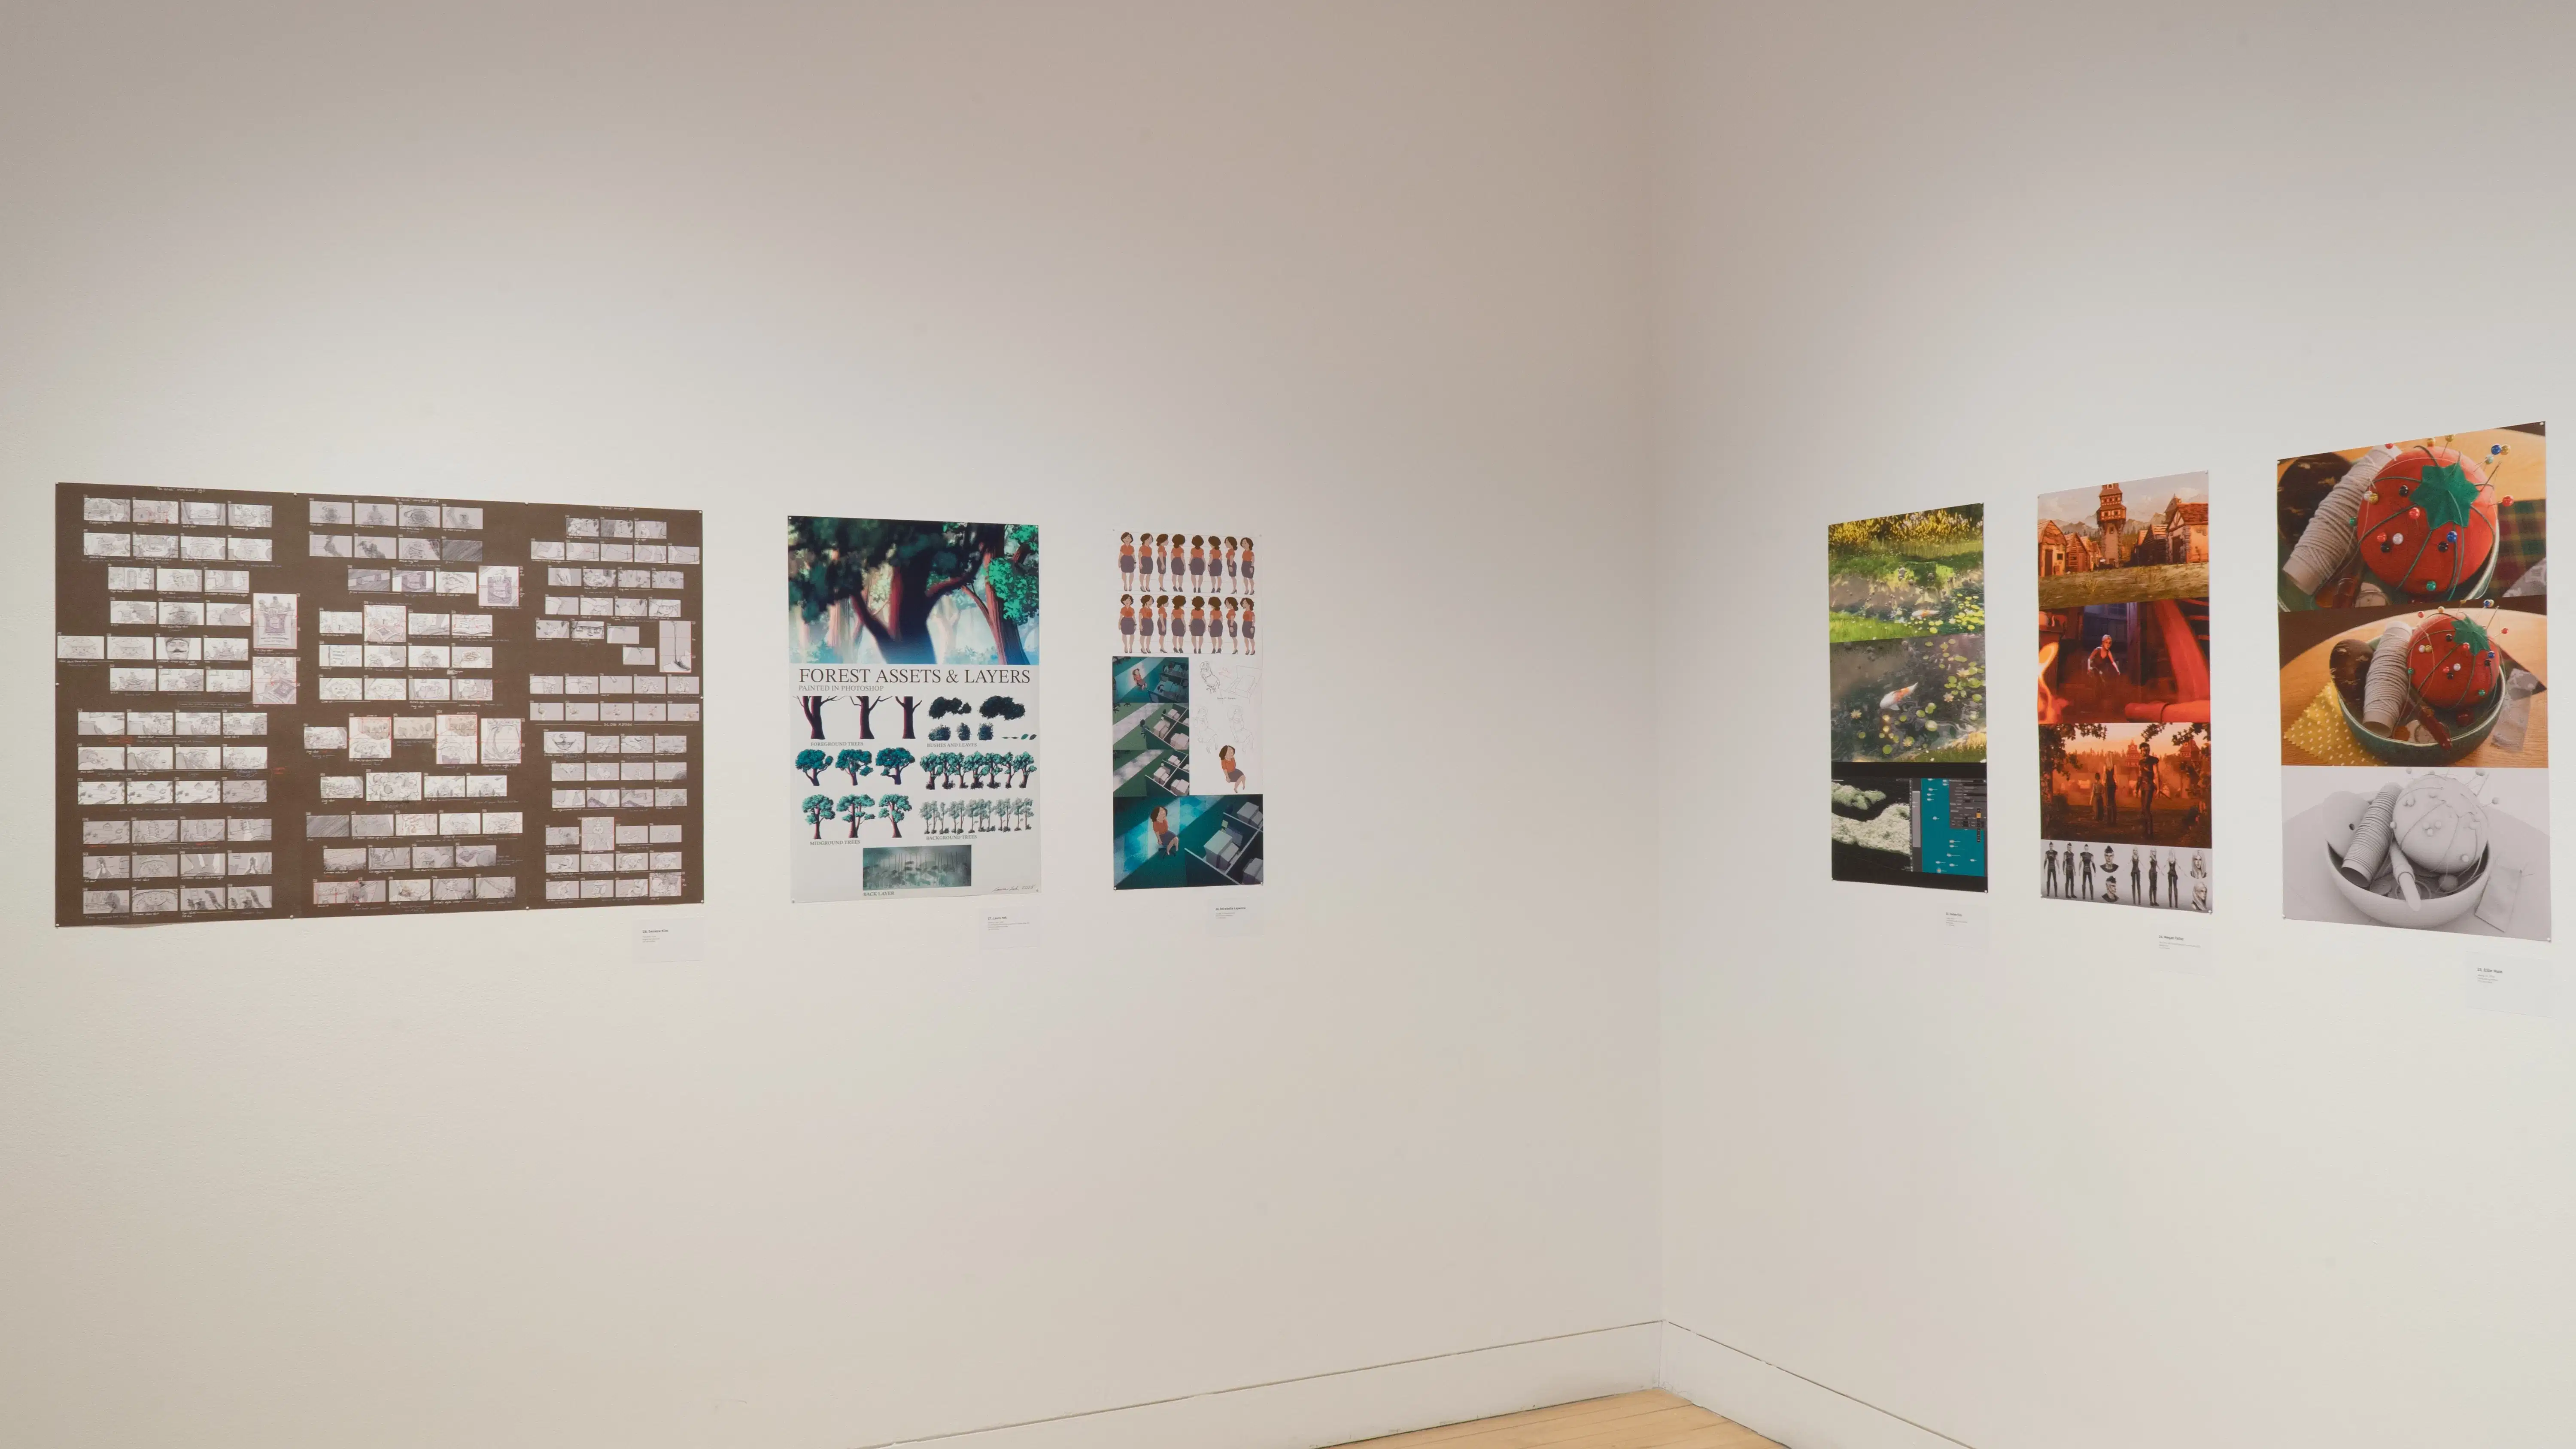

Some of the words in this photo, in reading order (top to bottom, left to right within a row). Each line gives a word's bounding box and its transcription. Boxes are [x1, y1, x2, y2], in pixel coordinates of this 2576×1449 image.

[799, 668, 871, 683] FOREST
[875, 669, 941, 683] ASSETS
[946, 669, 959, 683] &
[964, 669, 1030, 683] LAYERS
